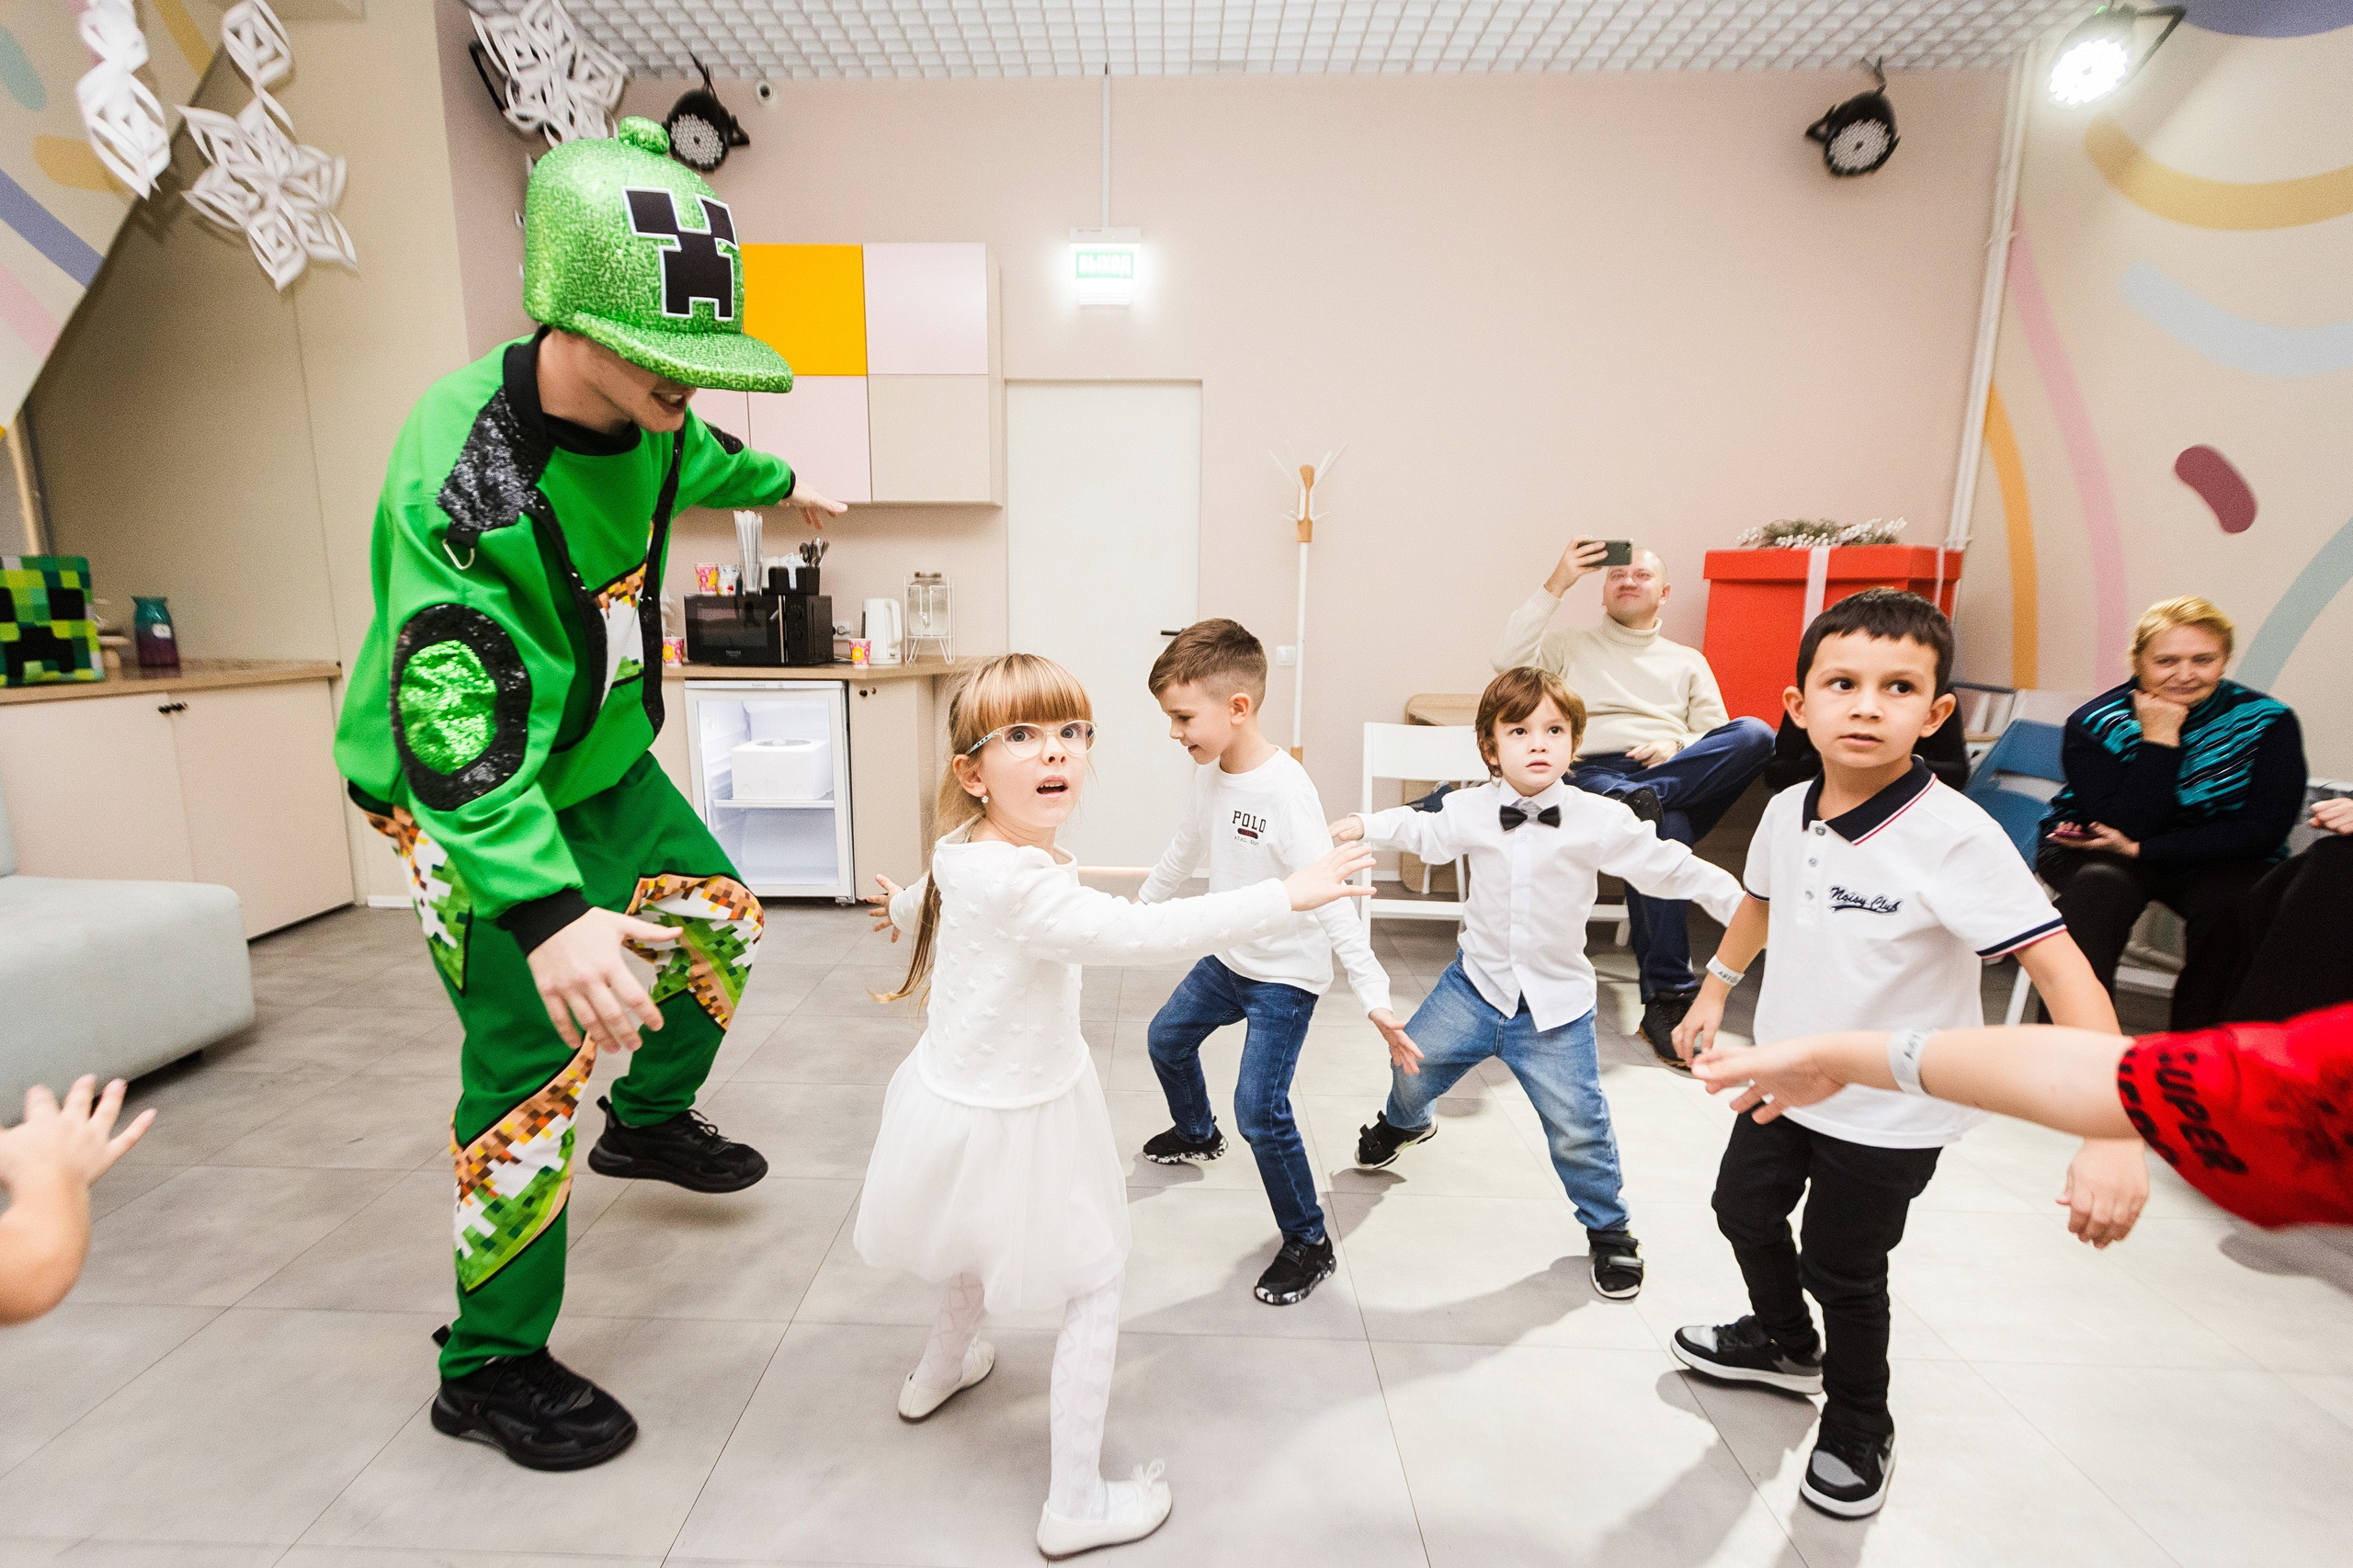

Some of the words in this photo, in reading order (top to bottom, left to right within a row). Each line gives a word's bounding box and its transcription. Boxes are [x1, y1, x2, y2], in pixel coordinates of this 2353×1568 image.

[1232, 810, 1267, 834] POLO
[1831, 886, 1866, 907] Noisy
[1870, 895, 1901, 912] Club
